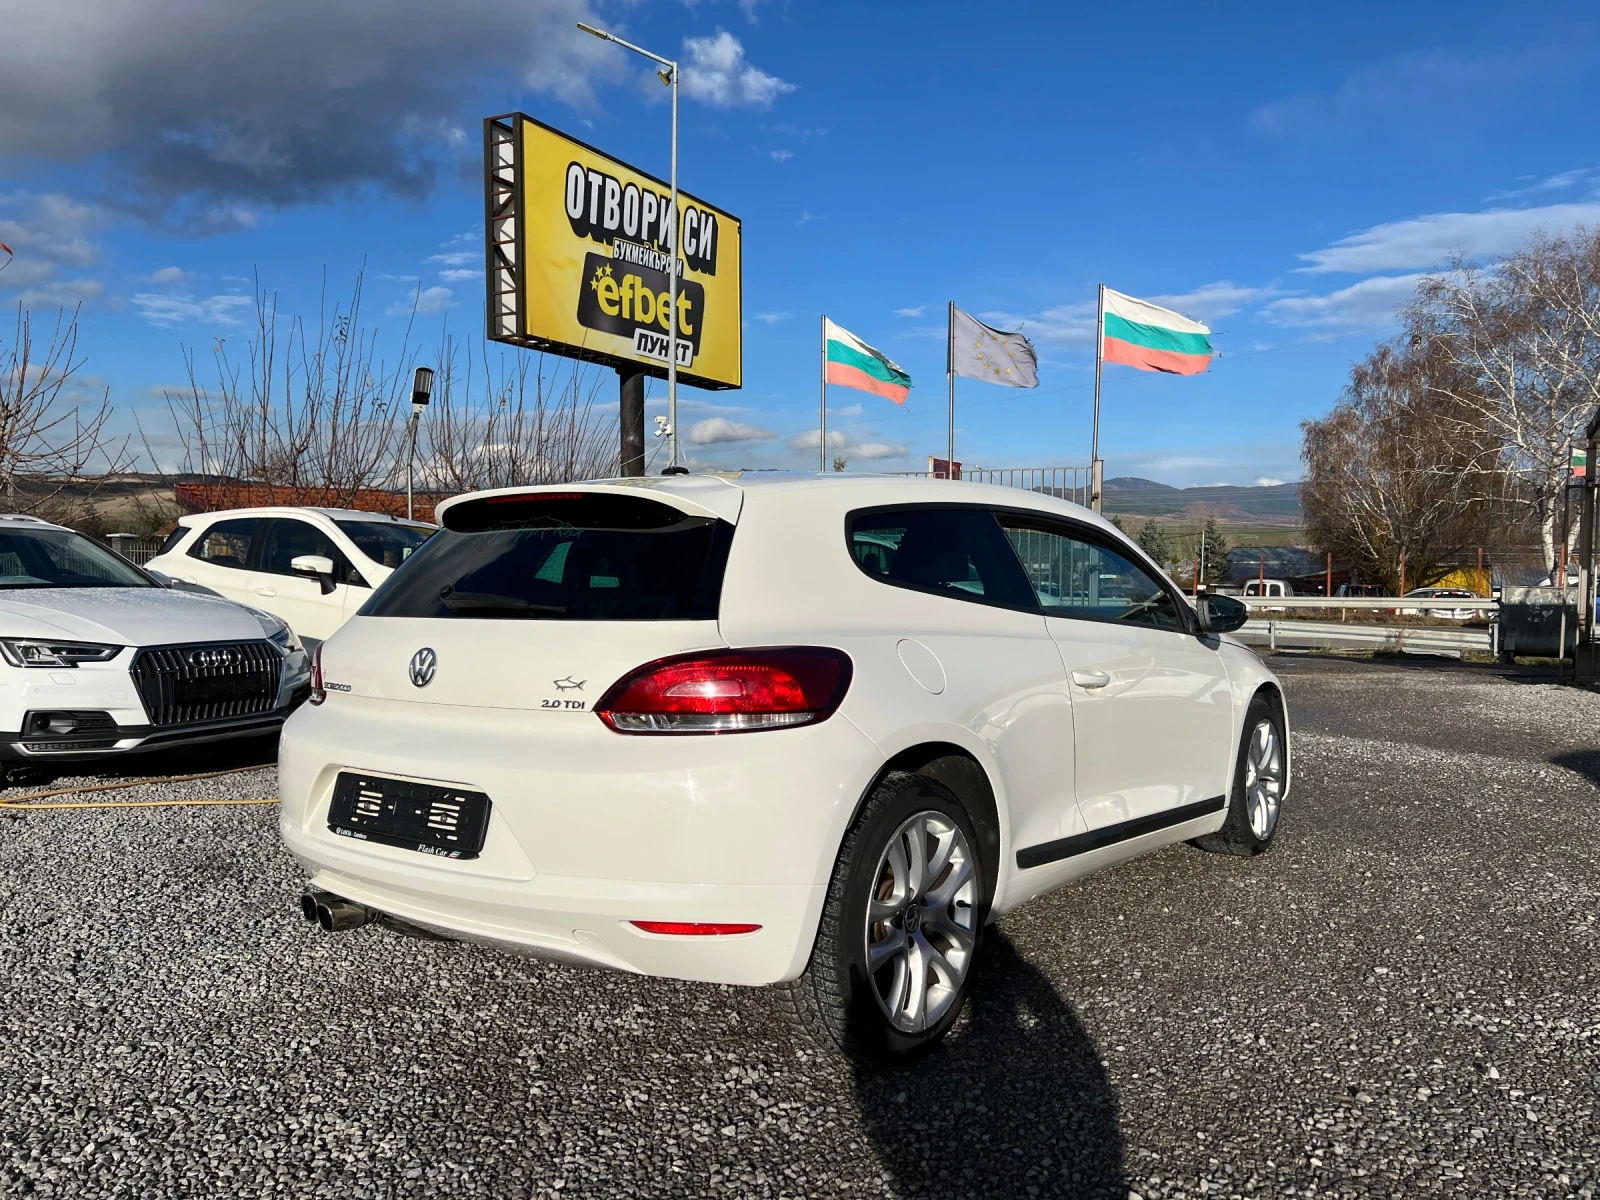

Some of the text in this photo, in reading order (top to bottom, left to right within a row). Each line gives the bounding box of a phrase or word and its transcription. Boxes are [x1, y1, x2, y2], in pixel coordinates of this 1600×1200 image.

[566, 164, 713, 260] ОТВОРИ СИ
[613, 239, 682, 277] БУКМЕЙКЪРСИ
[597, 273, 693, 336] efbet
[541, 699, 586, 709] 2.0 TDI
[417, 844, 448, 857] Flash Car
